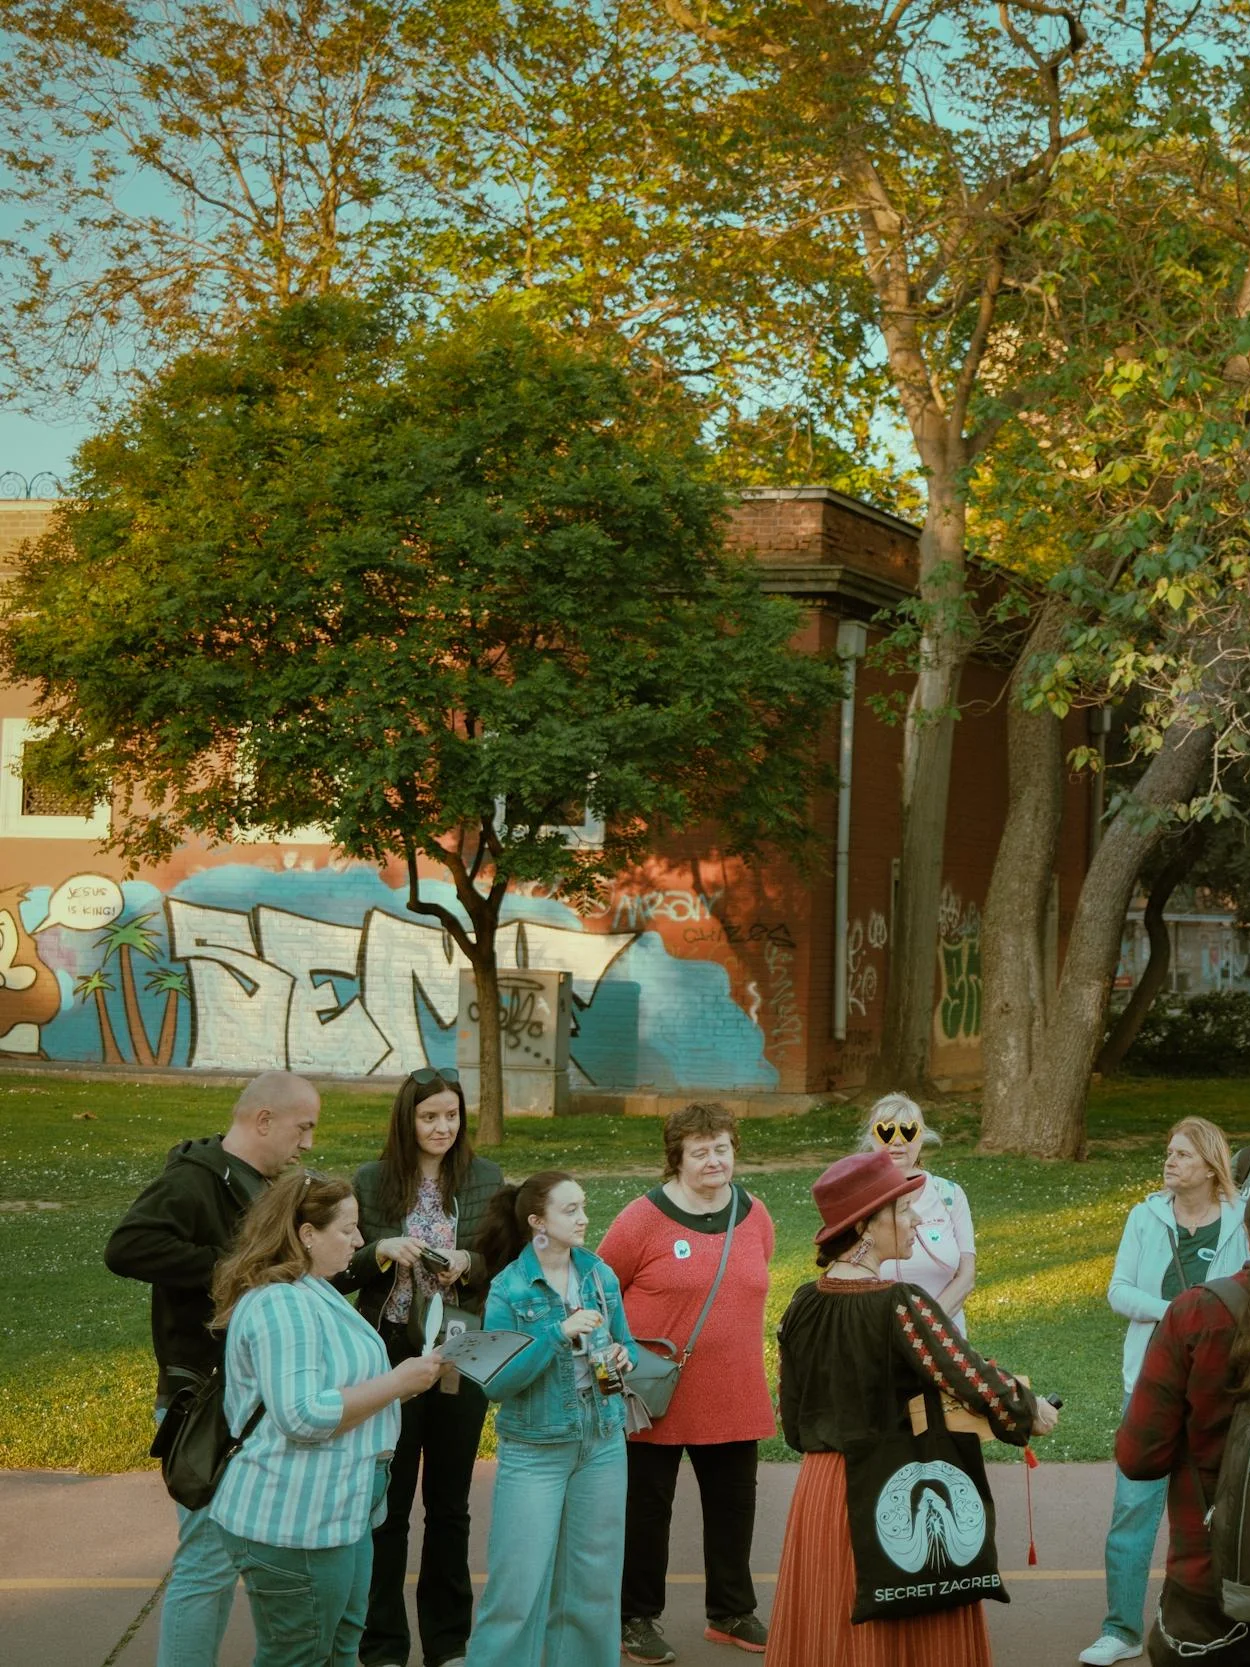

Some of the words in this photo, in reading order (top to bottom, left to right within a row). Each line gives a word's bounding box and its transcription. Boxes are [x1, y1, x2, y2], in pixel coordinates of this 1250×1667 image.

[67, 887, 108, 899] JESUS
[67, 905, 77, 914] IS
[82, 905, 115, 916] KING!
[875, 1583, 936, 1602] SECRET
[940, 1574, 1001, 1595] ZAGREB
